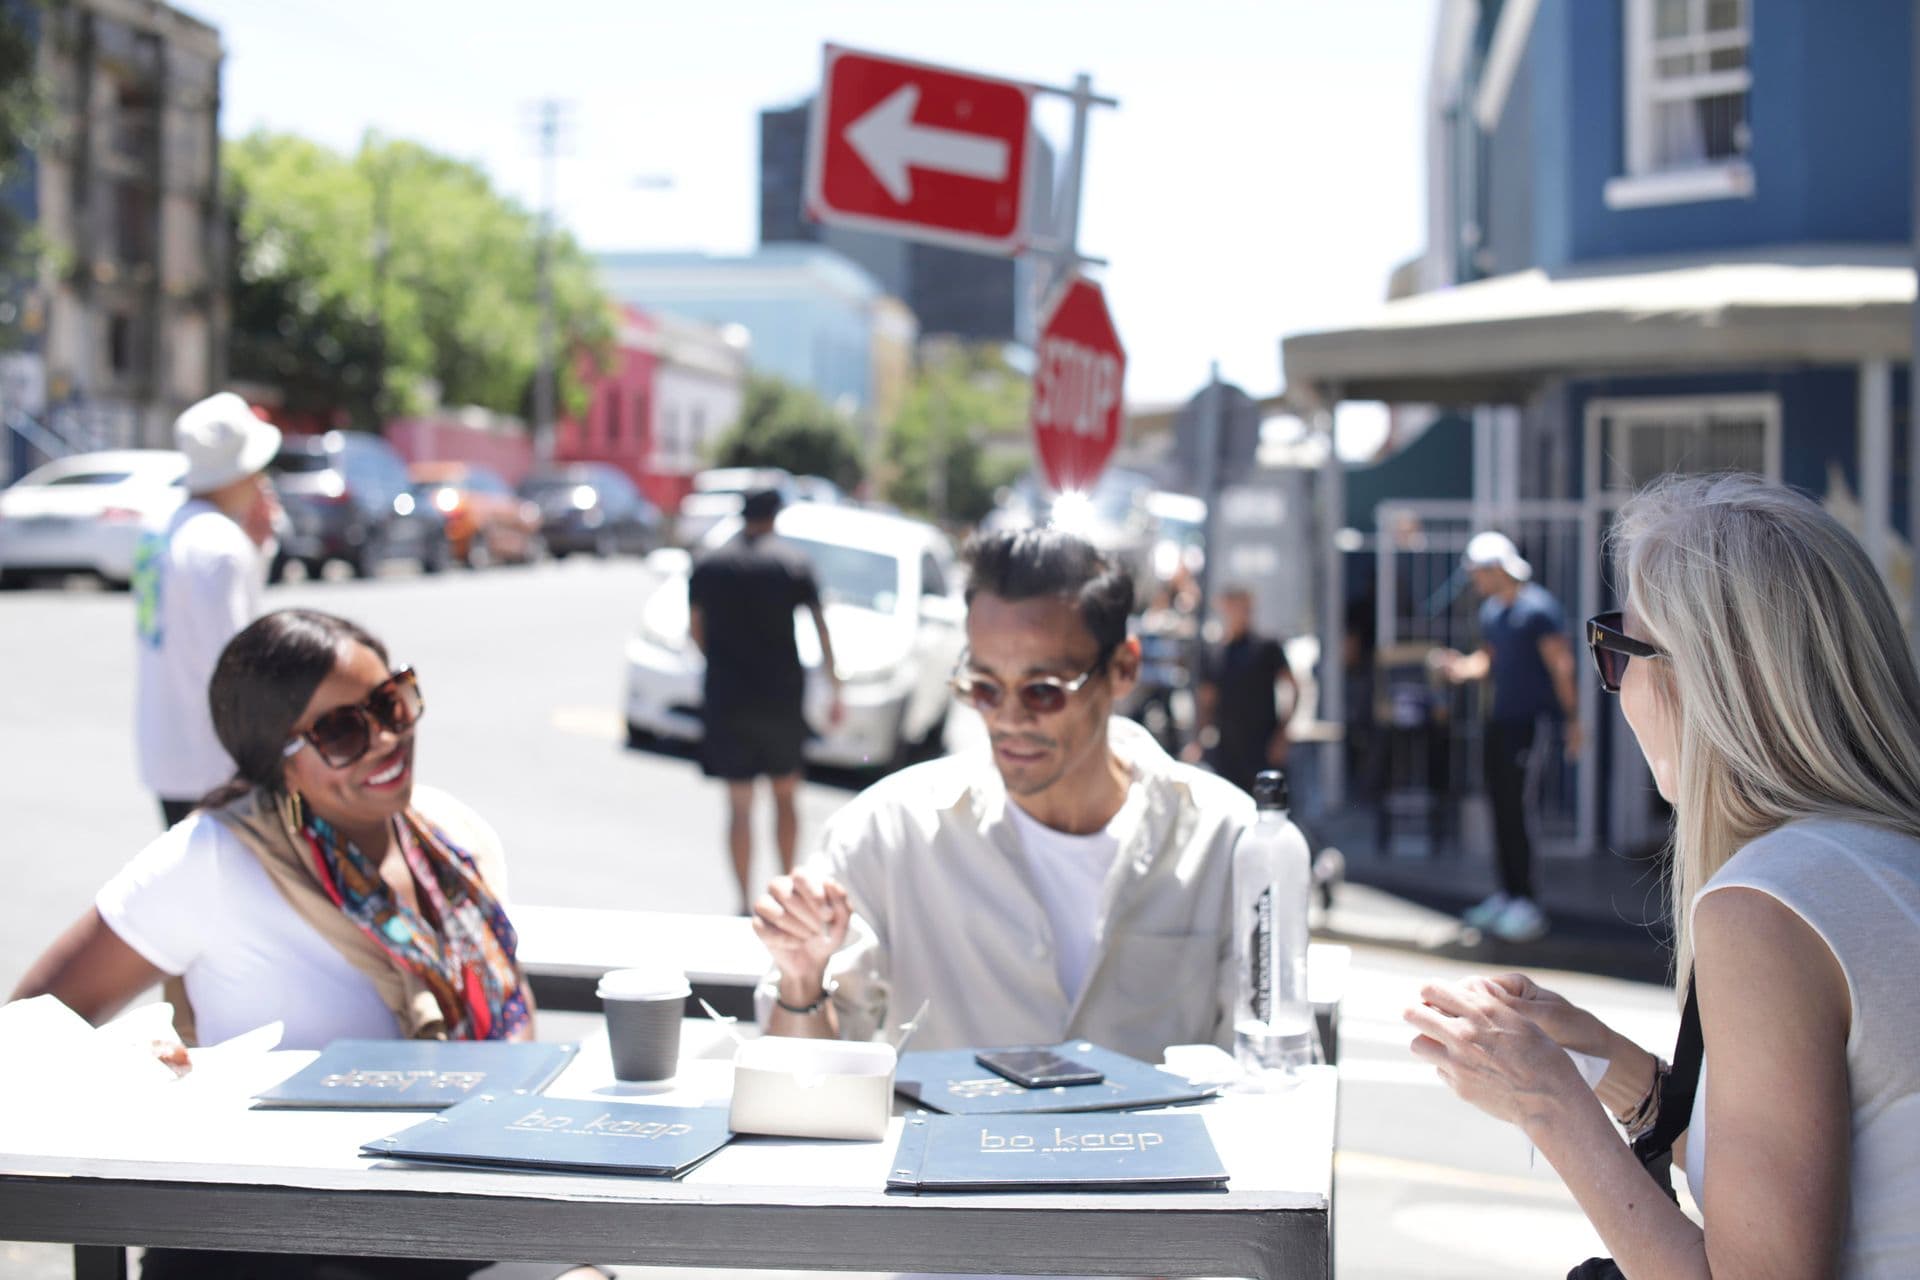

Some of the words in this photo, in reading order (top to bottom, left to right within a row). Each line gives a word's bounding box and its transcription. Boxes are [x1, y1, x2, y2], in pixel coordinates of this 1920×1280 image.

[1034, 337, 1119, 438] STOP
[512, 1108, 573, 1129] bo
[980, 1128, 1034, 1148] bo
[1055, 1127, 1164, 1151] kaap
